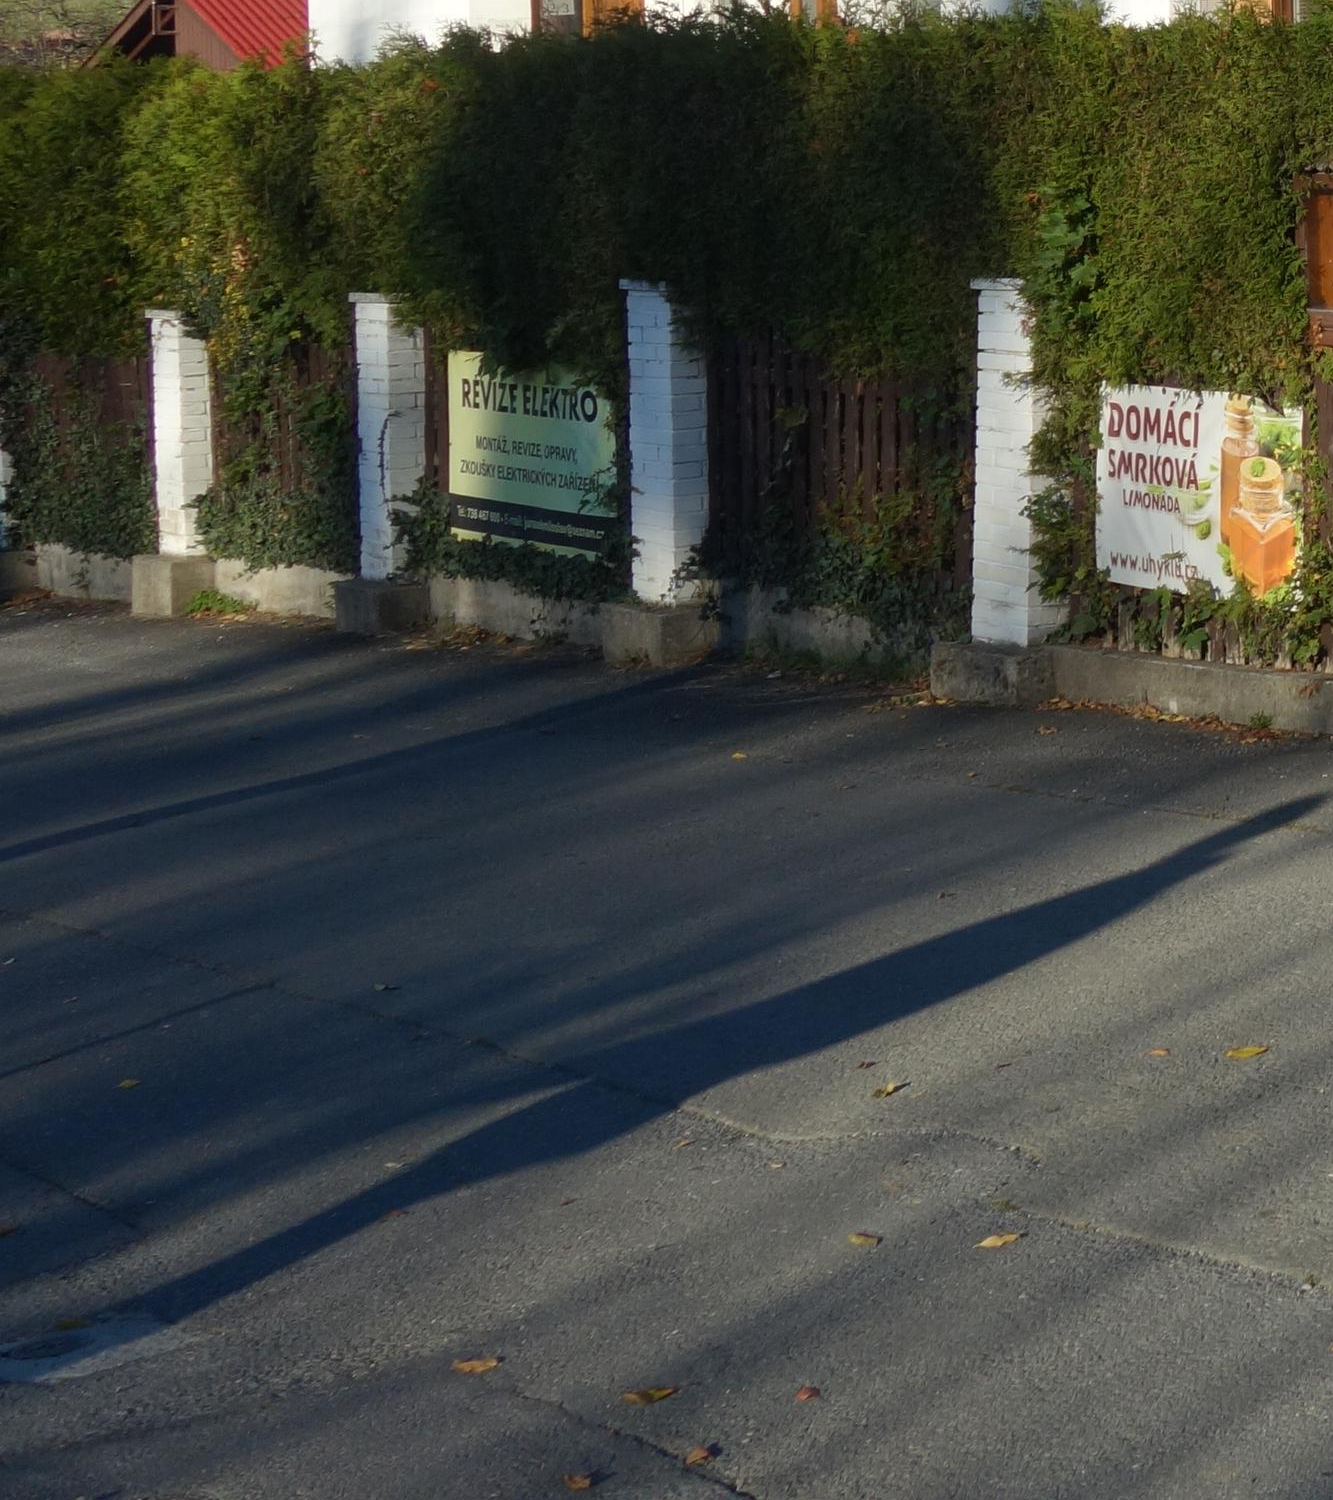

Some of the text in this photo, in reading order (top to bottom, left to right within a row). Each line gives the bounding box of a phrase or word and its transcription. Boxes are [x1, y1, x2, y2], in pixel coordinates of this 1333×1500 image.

[461, 378, 599, 423] REVIZE ELEKTRO
[1107, 400, 1200, 449] DOMÁCÍ
[475, 435, 578, 465] MONTÁŽ, REVIZE, OPRAVY,
[460, 458, 497, 479] ZKOUŠKY
[497, 465, 558, 487] ELEKTRICKÝCH
[1107, 449, 1200, 491] SMRKOVÁ
[1122, 489, 1181, 514] LIMONÁDA
